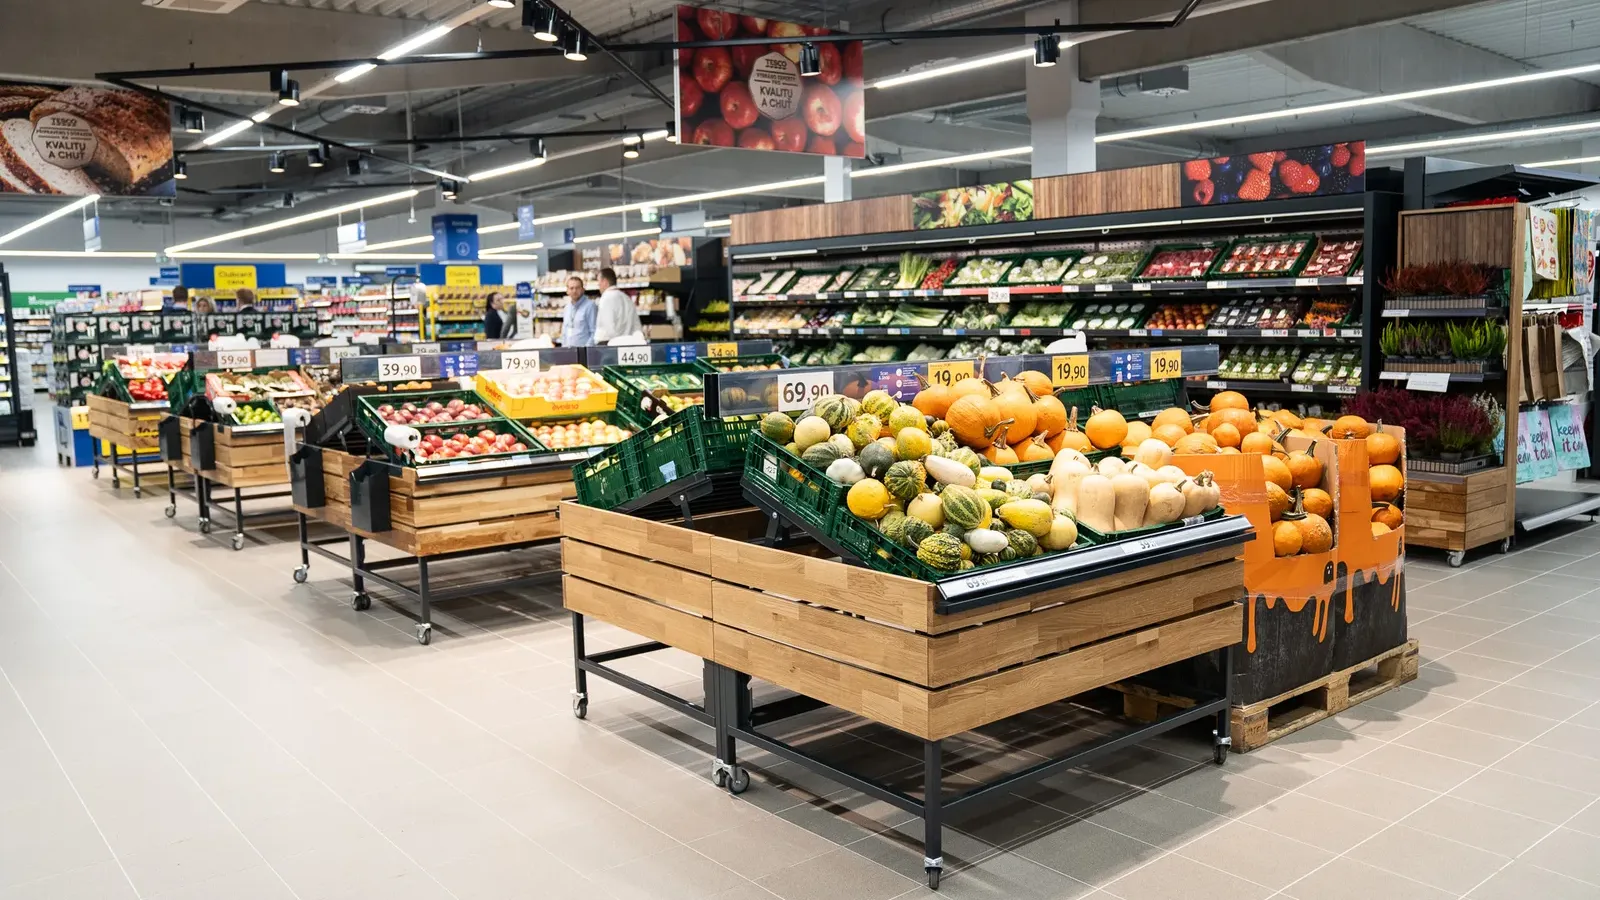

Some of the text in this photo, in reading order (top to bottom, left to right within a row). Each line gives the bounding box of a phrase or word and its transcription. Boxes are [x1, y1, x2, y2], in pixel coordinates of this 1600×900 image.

[765, 59, 787, 70] TESCO
[760, 86, 793, 98] KVALITU
[761, 98, 768, 107] A
[51, 117, 78, 127] TESCO
[45, 140, 86, 150] KVALITU
[621, 352, 650, 365] 44,90
[710, 347, 736, 358] 3490
[220, 355, 249, 365] 59,90
[505, 357, 537, 370] 79,90
[1154, 357, 1180, 375] 19,90
[382, 363, 418, 377] 39,90
[1057, 362, 1086, 382] 19,90
[783, 381, 830, 405] 69,90
